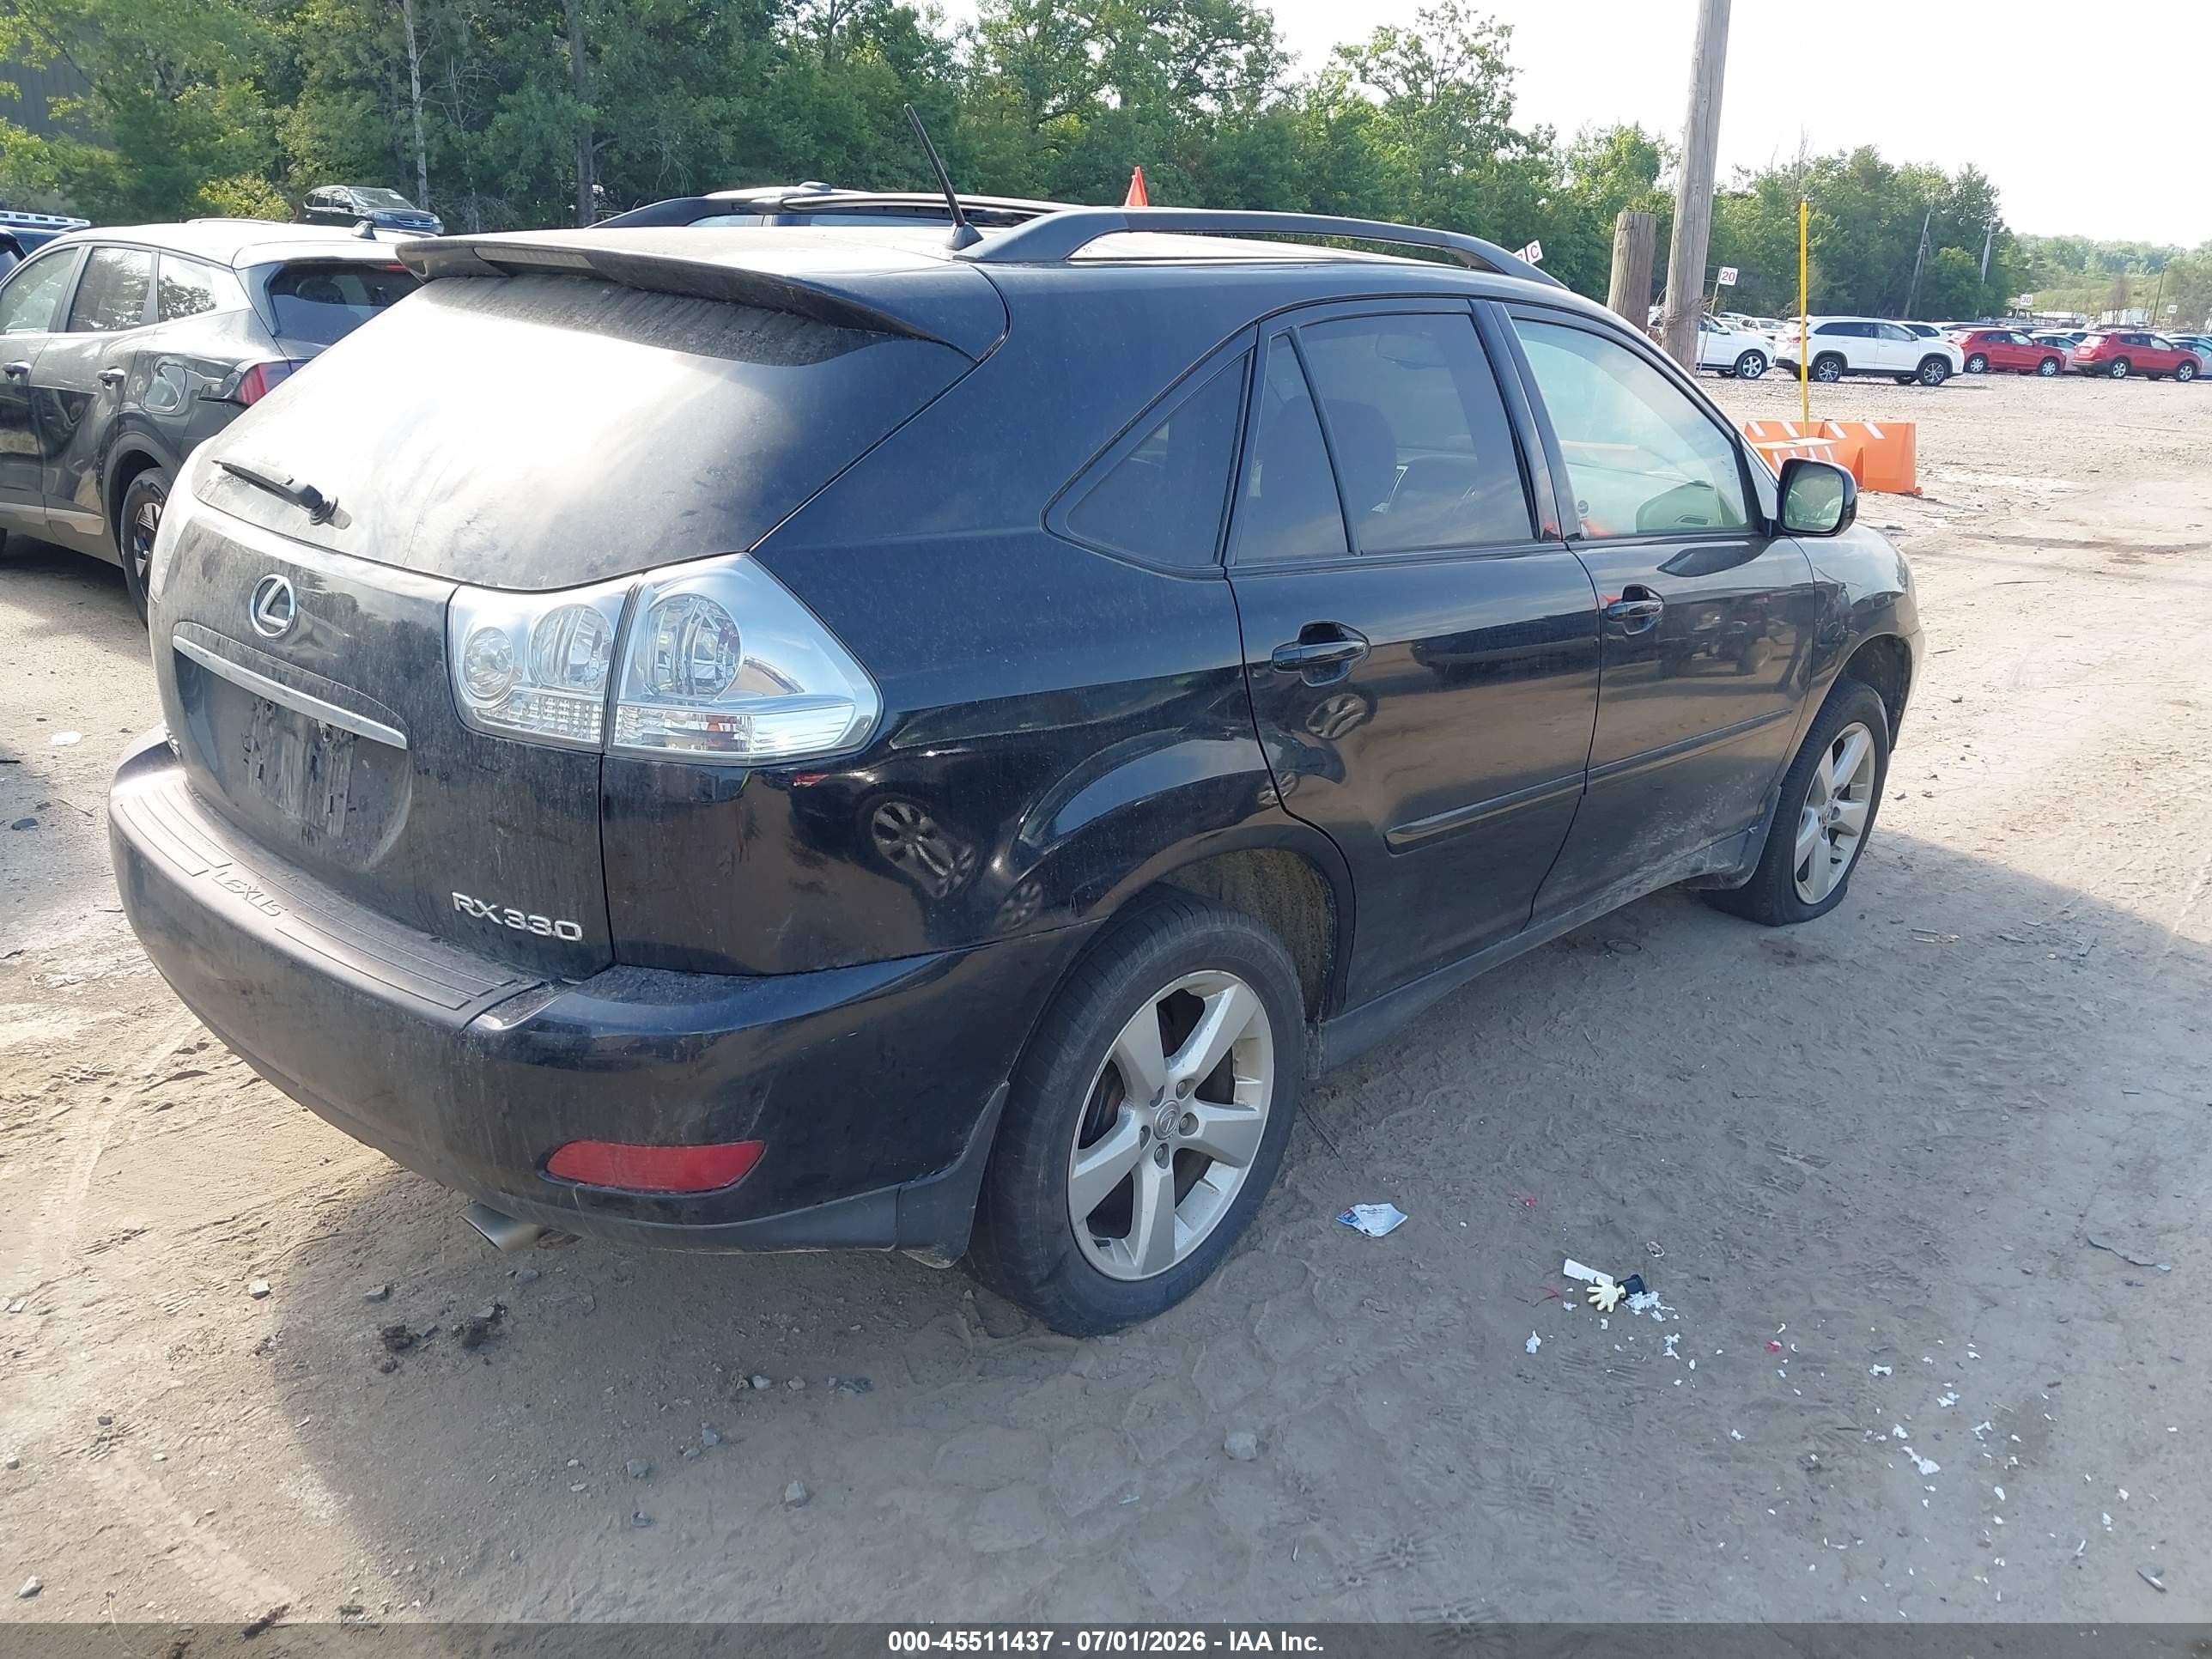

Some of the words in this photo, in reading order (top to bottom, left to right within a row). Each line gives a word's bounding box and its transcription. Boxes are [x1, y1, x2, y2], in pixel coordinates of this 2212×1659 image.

[1530, 245, 1540, 259] C
[1722, 271, 1735, 282] 20
[211, 871, 289, 917] LEXUS
